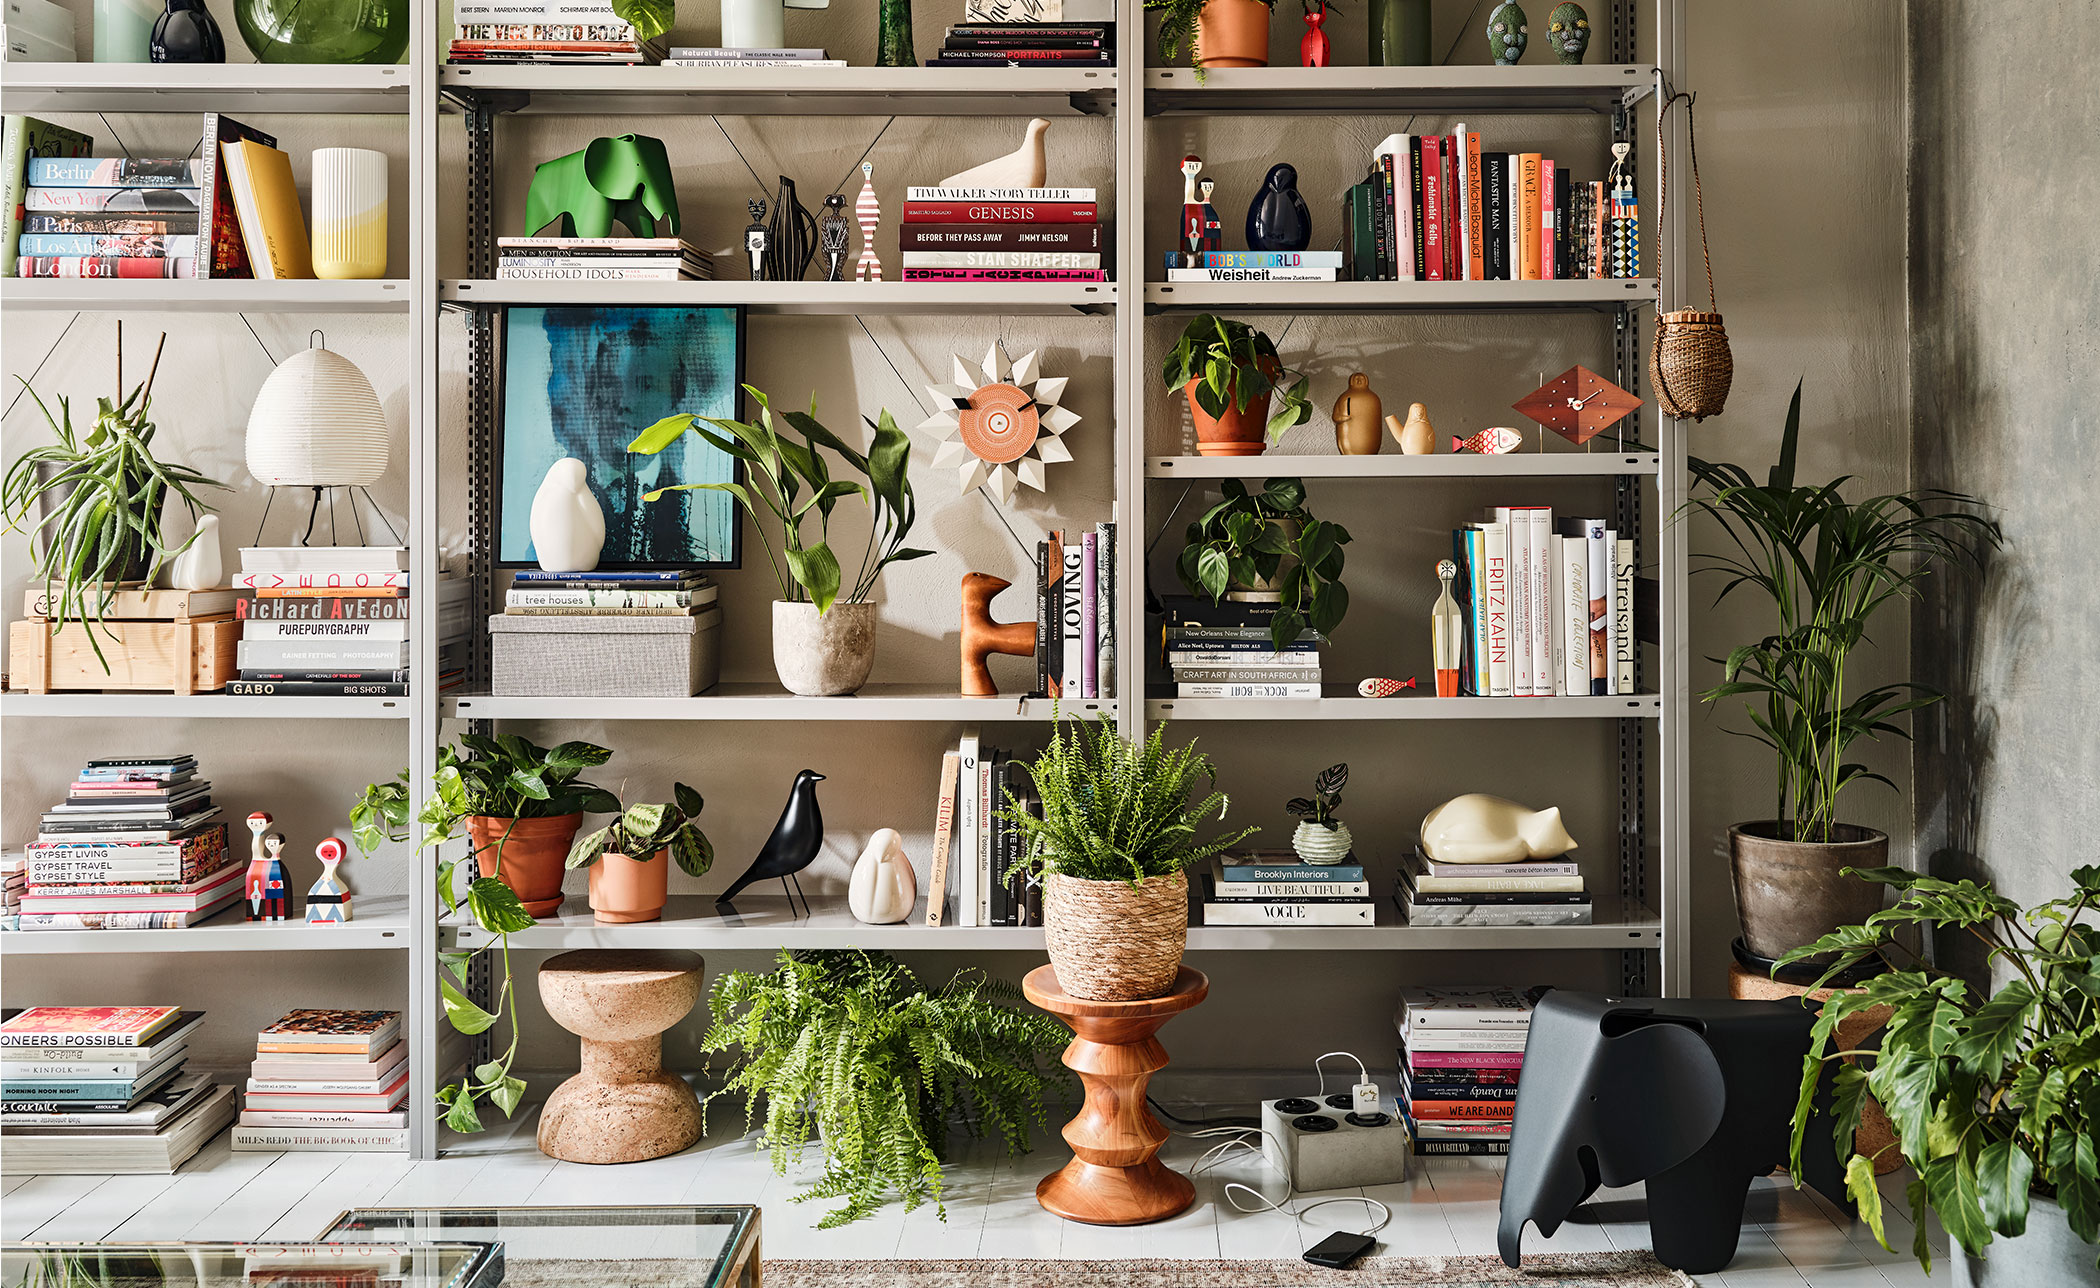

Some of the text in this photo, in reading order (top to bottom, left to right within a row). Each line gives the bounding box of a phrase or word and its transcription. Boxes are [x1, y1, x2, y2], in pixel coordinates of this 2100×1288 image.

[461, 25, 629, 40] THE VICE PHOTO BOOK
[715, 50, 741, 58] Beauty
[1007, 51, 1062, 59] PORTRAITS
[206, 117, 216, 154] BERLIN
[45, 164, 95, 180] Berlin
[205, 157, 215, 183] NOW
[1491, 160, 1499, 206] FANTASTIC
[42, 192, 110, 206] New York
[914, 189, 1070, 199] TIM WALKER STORY TELLER
[204, 186, 213, 220] DAGMAR
[1470, 151, 1481, 258] Jean-Michel Basquiat
[969, 207, 1034, 219] GENESIS
[1492, 209, 1500, 229] MAN
[43, 220, 82, 233] Paris
[1018, 234, 1040, 242] JIMMY
[36, 238, 131, 256] Los Angeles
[201, 240, 210, 265] TAUBE
[967, 253, 1080, 267] STAN SHAFFER
[1209, 254, 1300, 266] BOB'S WORLD
[36, 258, 112, 276] London
[502, 269, 624, 279] HOUSEHOLD IDOLS
[906, 271, 1095, 280] HOTEL LACHAPELLE
[1209, 269, 1270, 281] Weisheit
[243, 574, 397, 587] AVEDON
[526, 595, 584, 605] tree houses
[1065, 553, 1081, 640] LOVING
[236, 599, 408, 619] RicHard AvEdoN
[1489, 557, 1506, 663] FRITZ KAHN
[1616, 564, 1634, 662] Streisand
[1571, 563, 1585, 670] CORPORATE COLLECTIONS
[279, 624, 370, 635] PUREPURYGRAPHY
[1183, 671, 1297, 679] CRAFT ART IN SOUTH AFRICA
[233, 685, 386, 694] GABO BIG SHOTS
[1230, 686, 1288, 696] ROCK BOAT
[938, 796, 952, 832] KILIM
[35, 850, 108, 859] GYPSET LIVING
[35, 862, 112, 871] GYPSET TRAVEL
[35, 872, 105, 881] GYPSET STYLE
[1255, 870, 1329, 879] Brooklyn Interiors
[1257, 885, 1344, 895] LIVE BEAUTIFUL
[1264, 906, 1306, 918] VOGUE
[65, 1036, 133, 1046] POSSIBLE
[43, 1050, 83, 1060] Build-On
[1470, 1086, 1502, 1098] Dandy
[1450, 1106, 1463, 1115] WE
[1466, 1106, 1483, 1115] ARE
[238, 1136, 265, 1144] MILES
[267, 1136, 291, 1144] REDD
